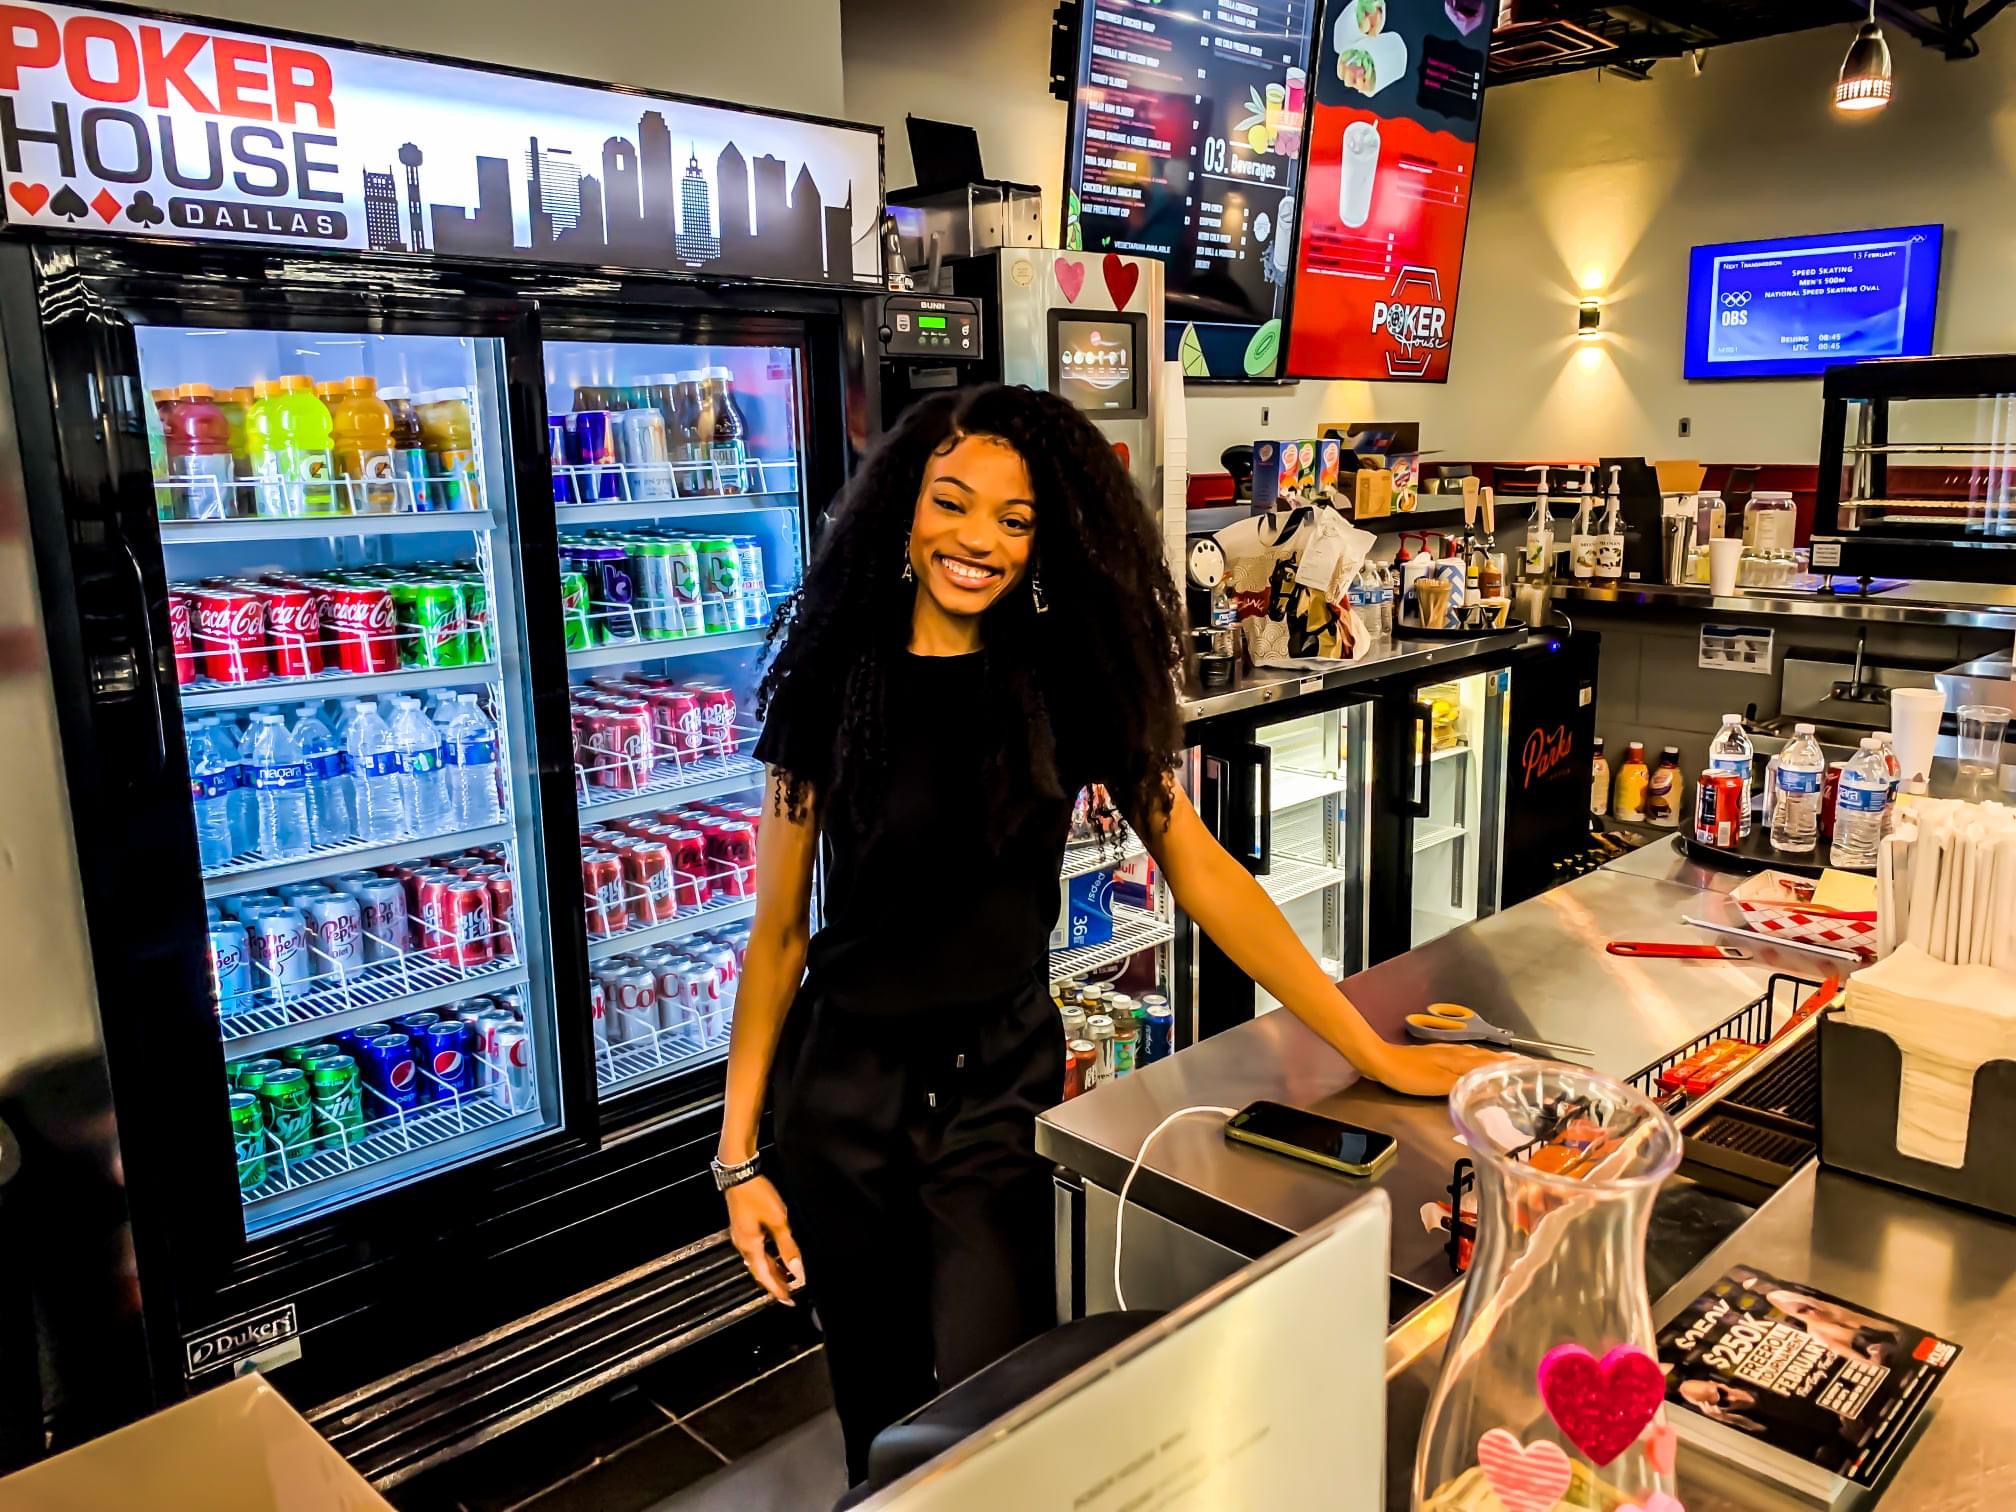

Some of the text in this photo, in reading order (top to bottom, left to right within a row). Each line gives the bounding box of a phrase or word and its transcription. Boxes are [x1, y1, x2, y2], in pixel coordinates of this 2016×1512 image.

[0, 4, 336, 129] POKER
[0, 96, 344, 203] HOUSE
[1231, 153, 1276, 182] Beverages
[185, 204, 334, 236] DALLAS
[1371, 301, 1446, 338] POKER
[1721, 309, 1748, 327] OBS
[259, 766, 302, 782] niagara
[1073, 915, 1088, 935] 36
[1702, 1311, 1777, 1371] $250K
